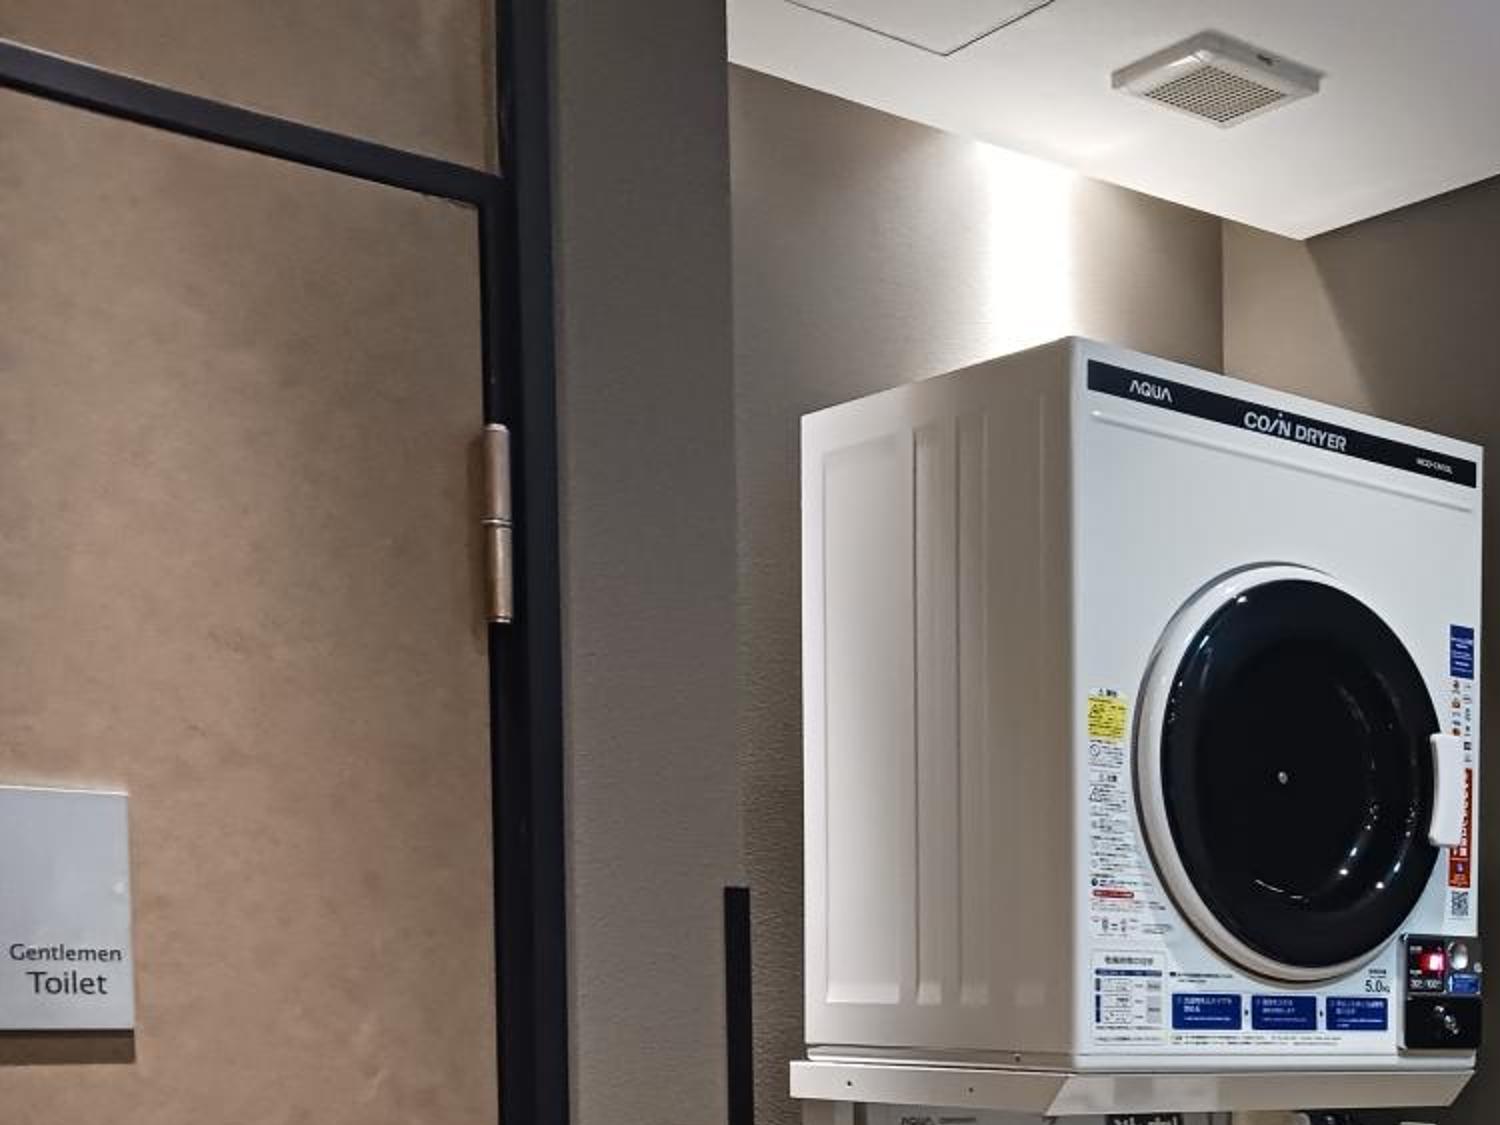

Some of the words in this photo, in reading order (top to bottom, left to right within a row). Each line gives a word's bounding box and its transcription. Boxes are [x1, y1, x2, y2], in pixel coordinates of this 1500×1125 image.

[1129, 379, 1174, 402] AQUA
[1243, 411, 1292, 438] COIN
[1295, 425, 1348, 452] DRYER
[9, 943, 123, 962] Gentlemen
[26, 970, 108, 995] Toilet
